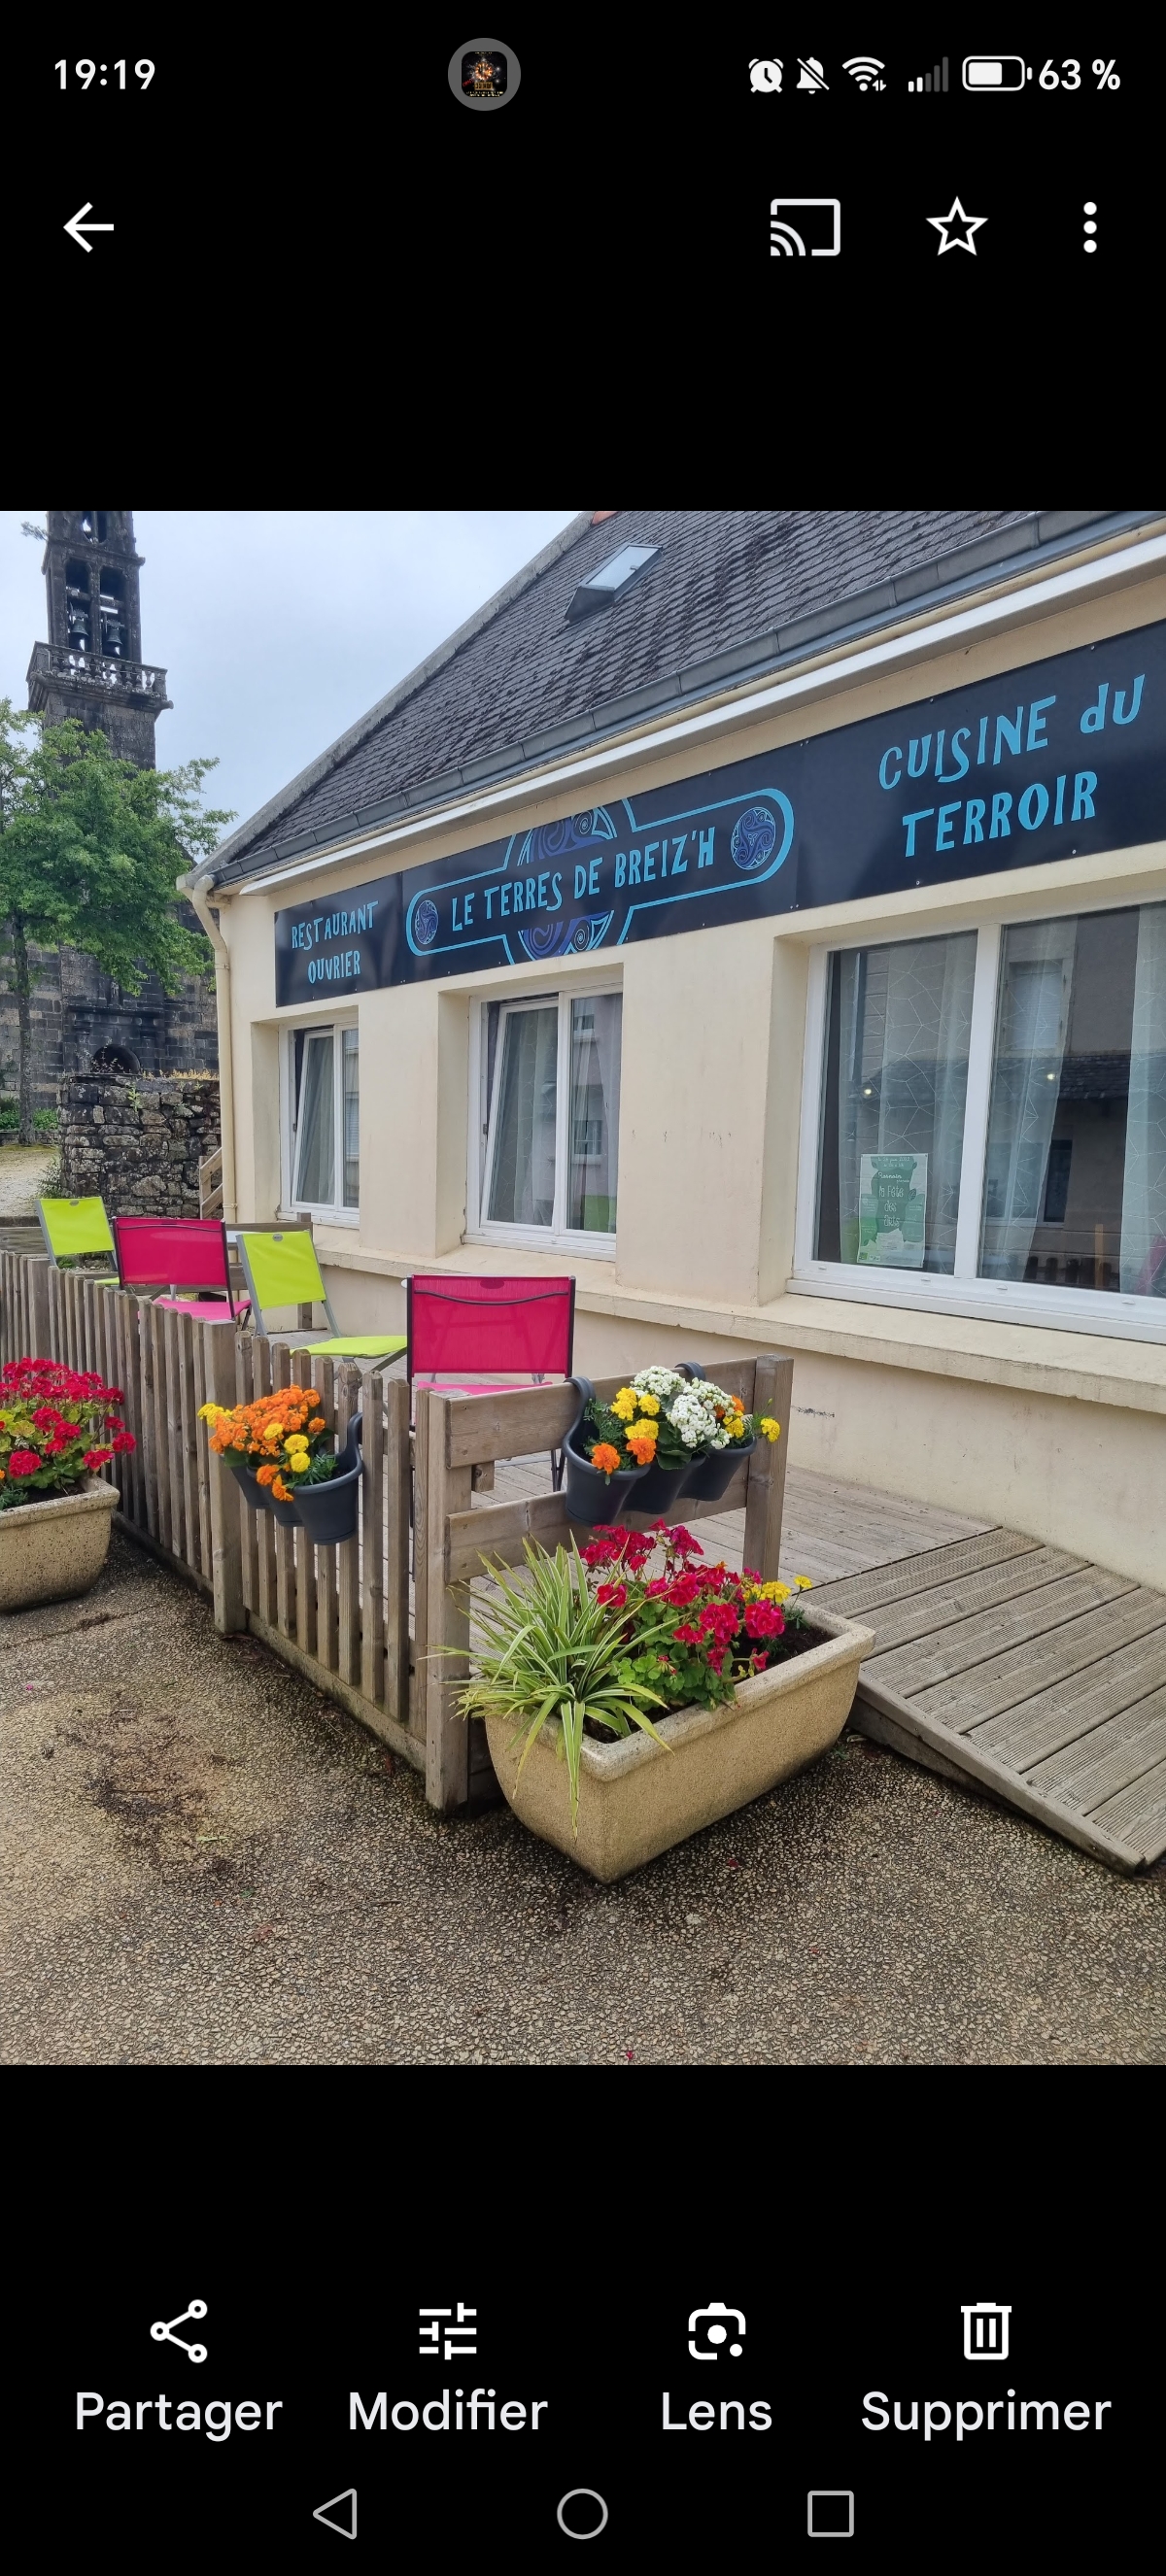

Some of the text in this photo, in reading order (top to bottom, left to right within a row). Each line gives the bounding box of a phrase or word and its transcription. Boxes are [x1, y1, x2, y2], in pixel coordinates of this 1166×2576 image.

[878, 695, 1056, 790] CUISINE
[902, 770, 1098, 858] TERROIR
[452, 826, 716, 932] LE TERRES DE BREIZ'H
[292, 899, 380, 952] RESTAURANT
[307, 952, 361, 984] OUVRIER
